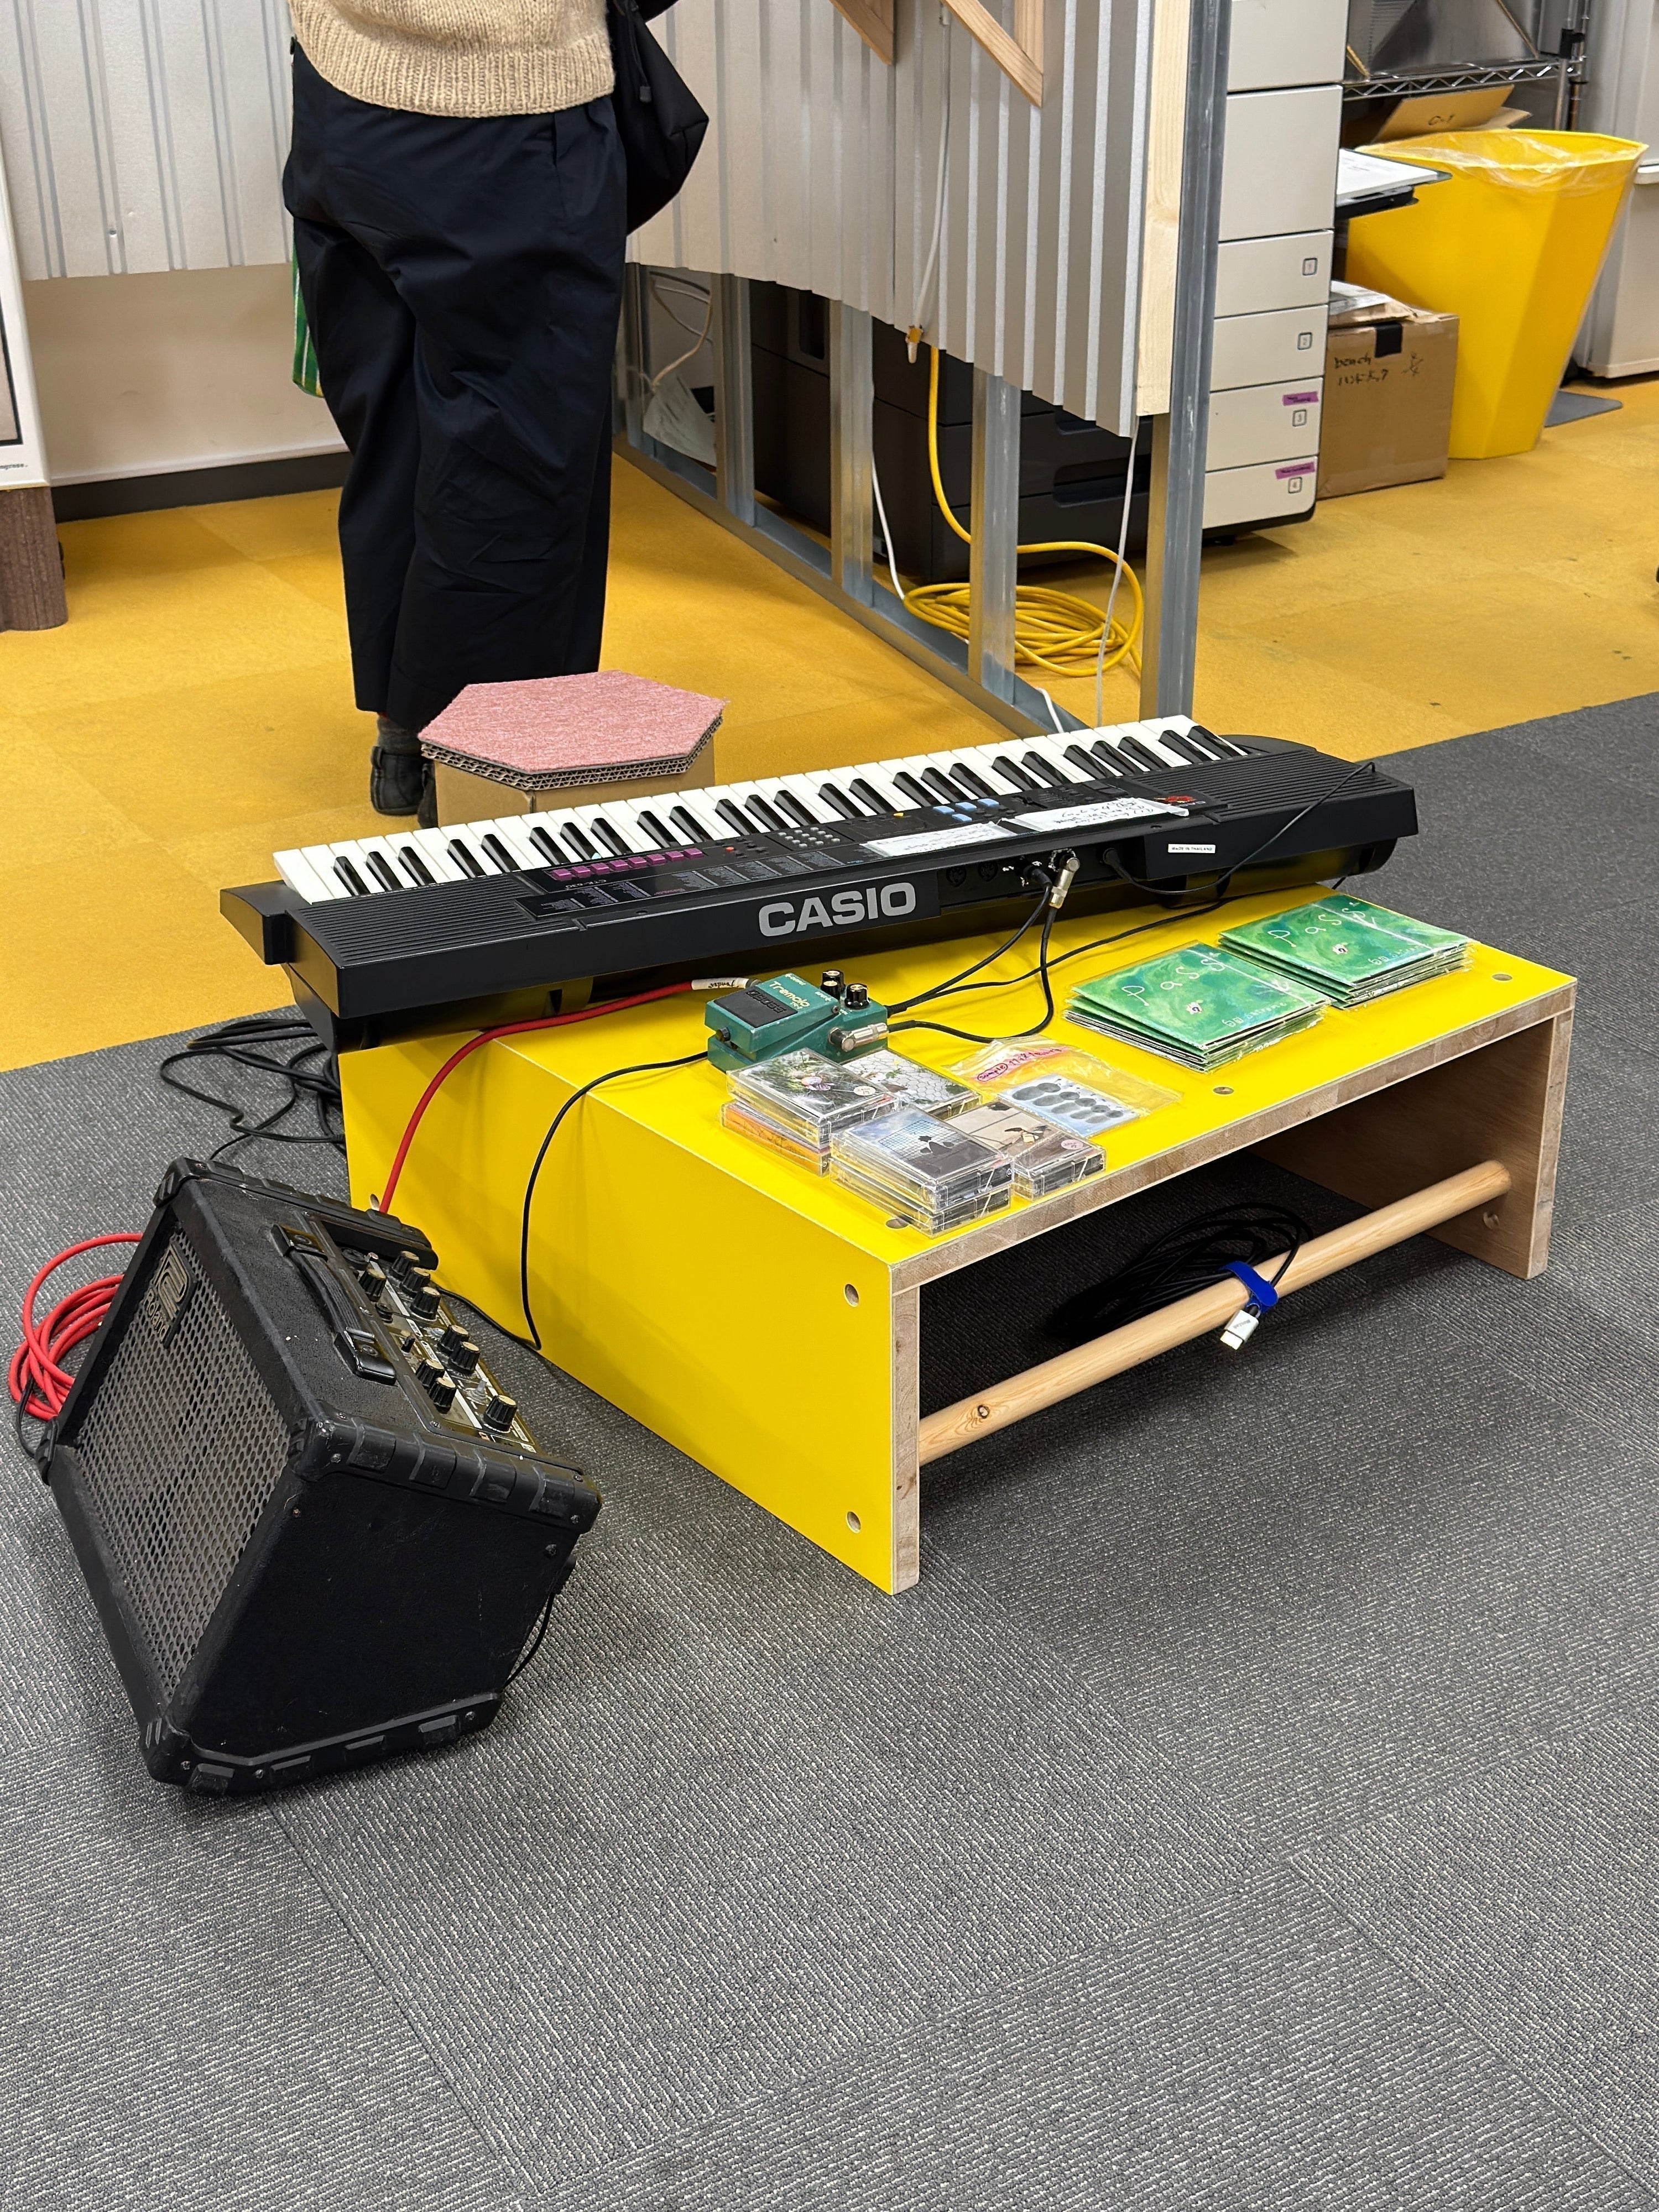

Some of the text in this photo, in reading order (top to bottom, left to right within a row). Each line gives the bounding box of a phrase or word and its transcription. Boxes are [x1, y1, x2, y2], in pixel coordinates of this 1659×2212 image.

[759, 882, 916, 937] CASIO
[752, 991, 786, 1013] BOSS
[769, 981, 810, 1007] Tremolo
[144, 1288, 170, 1342] Roland
